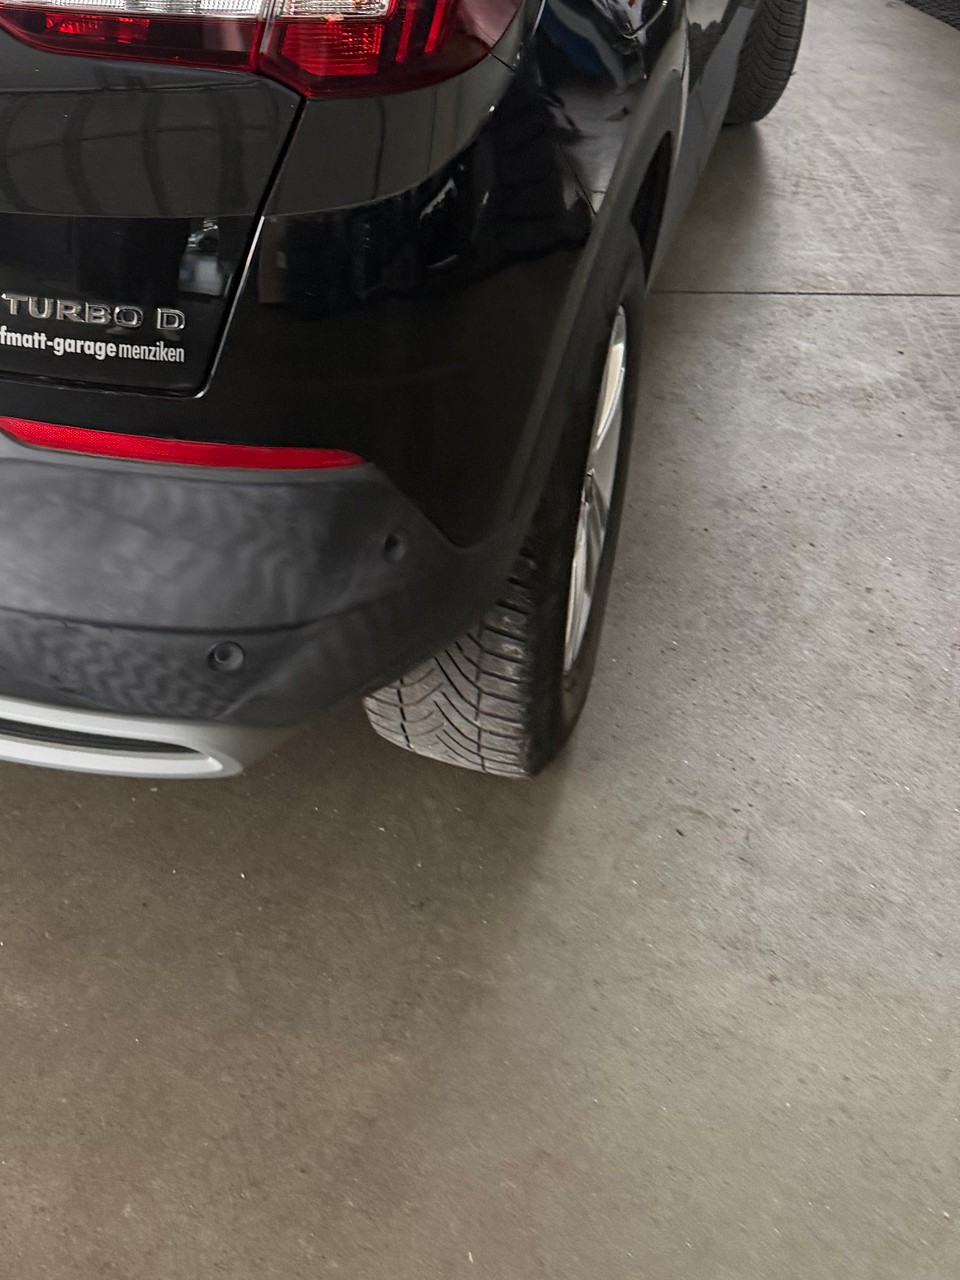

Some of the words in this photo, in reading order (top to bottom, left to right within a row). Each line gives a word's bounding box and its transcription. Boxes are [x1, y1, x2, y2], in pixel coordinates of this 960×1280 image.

[1, 293, 144, 329] TURBO
[157, 307, 186, 331] D
[119, 341, 185, 363] menziken
